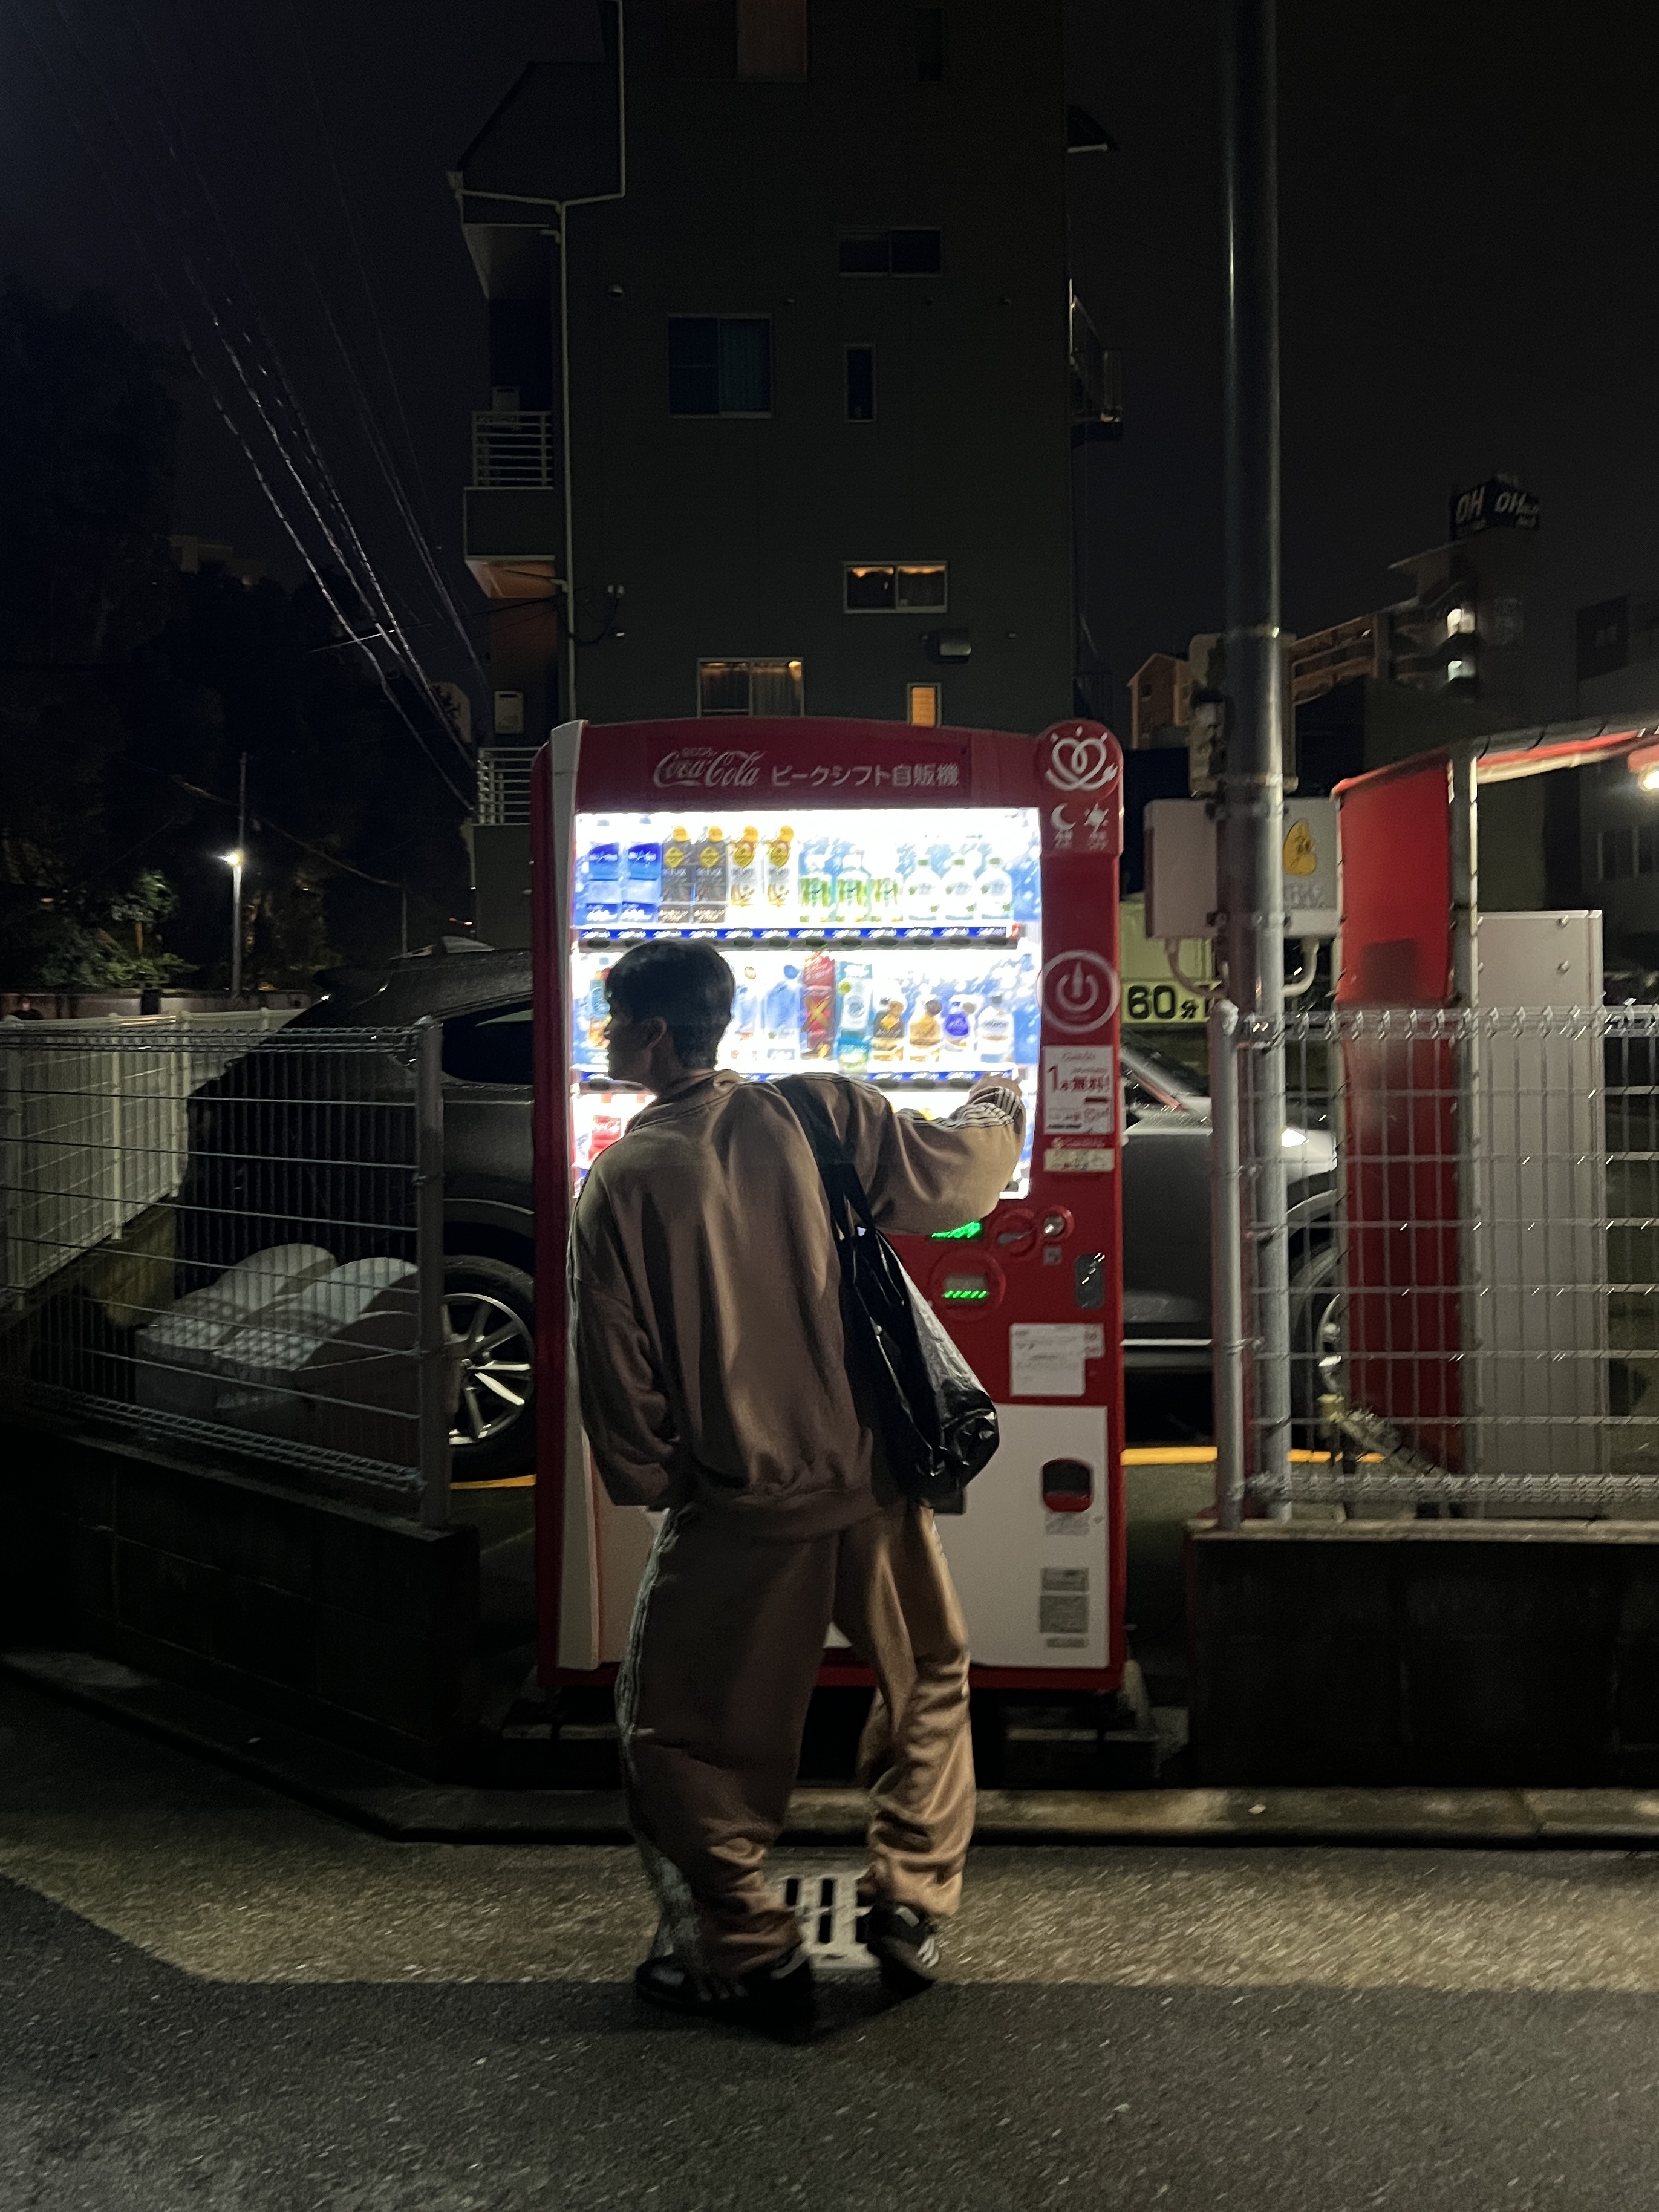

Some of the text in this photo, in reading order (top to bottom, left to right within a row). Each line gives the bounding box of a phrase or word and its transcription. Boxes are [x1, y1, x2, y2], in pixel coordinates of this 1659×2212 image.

[653, 751, 767, 788] Coca-Cola
[771, 763, 959, 786] ピークシフト自販機
